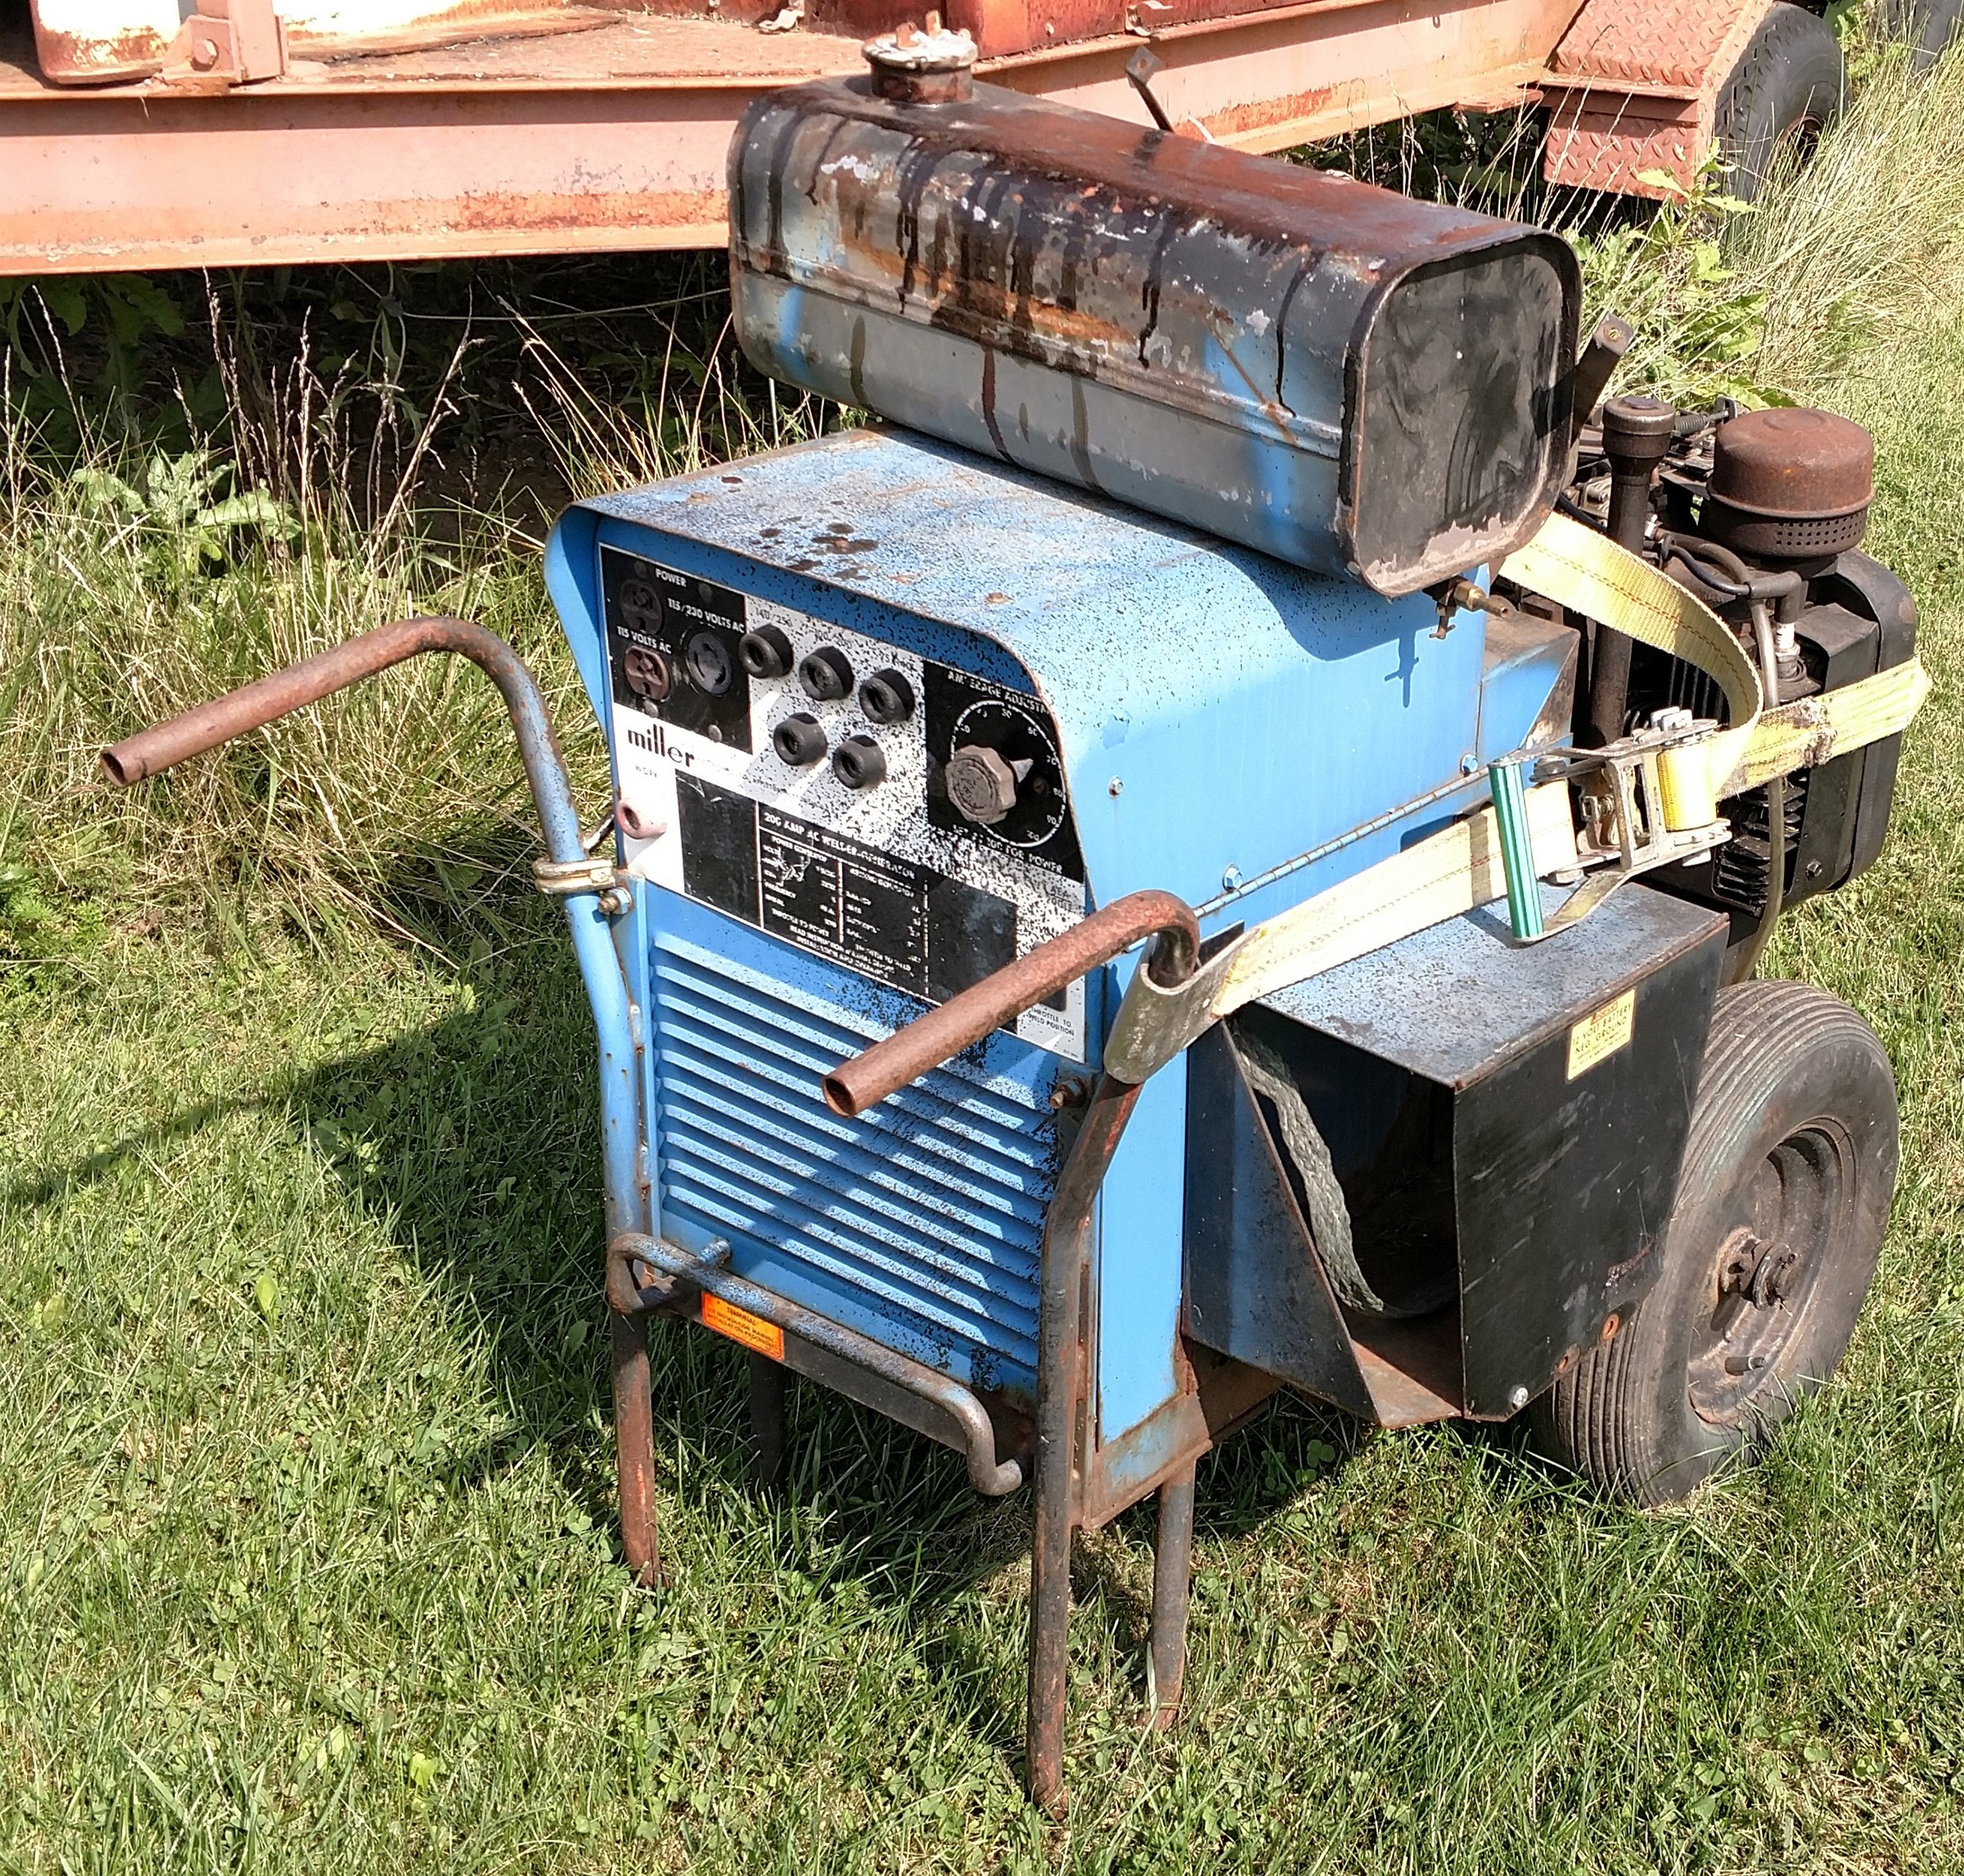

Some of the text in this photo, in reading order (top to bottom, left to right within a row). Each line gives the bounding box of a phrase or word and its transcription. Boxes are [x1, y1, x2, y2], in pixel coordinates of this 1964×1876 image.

[655, 568, 687, 587] POWER
[668, 597, 746, 634] 115/230 VOLTS AC
[617, 626, 672, 655] 115 VOLTS AC
[628, 723, 695, 767] miller
[784, 821, 805, 836] AMP
[806, 830, 821, 843] AC
[1603, 1003, 1632, 1027] BATTERY
